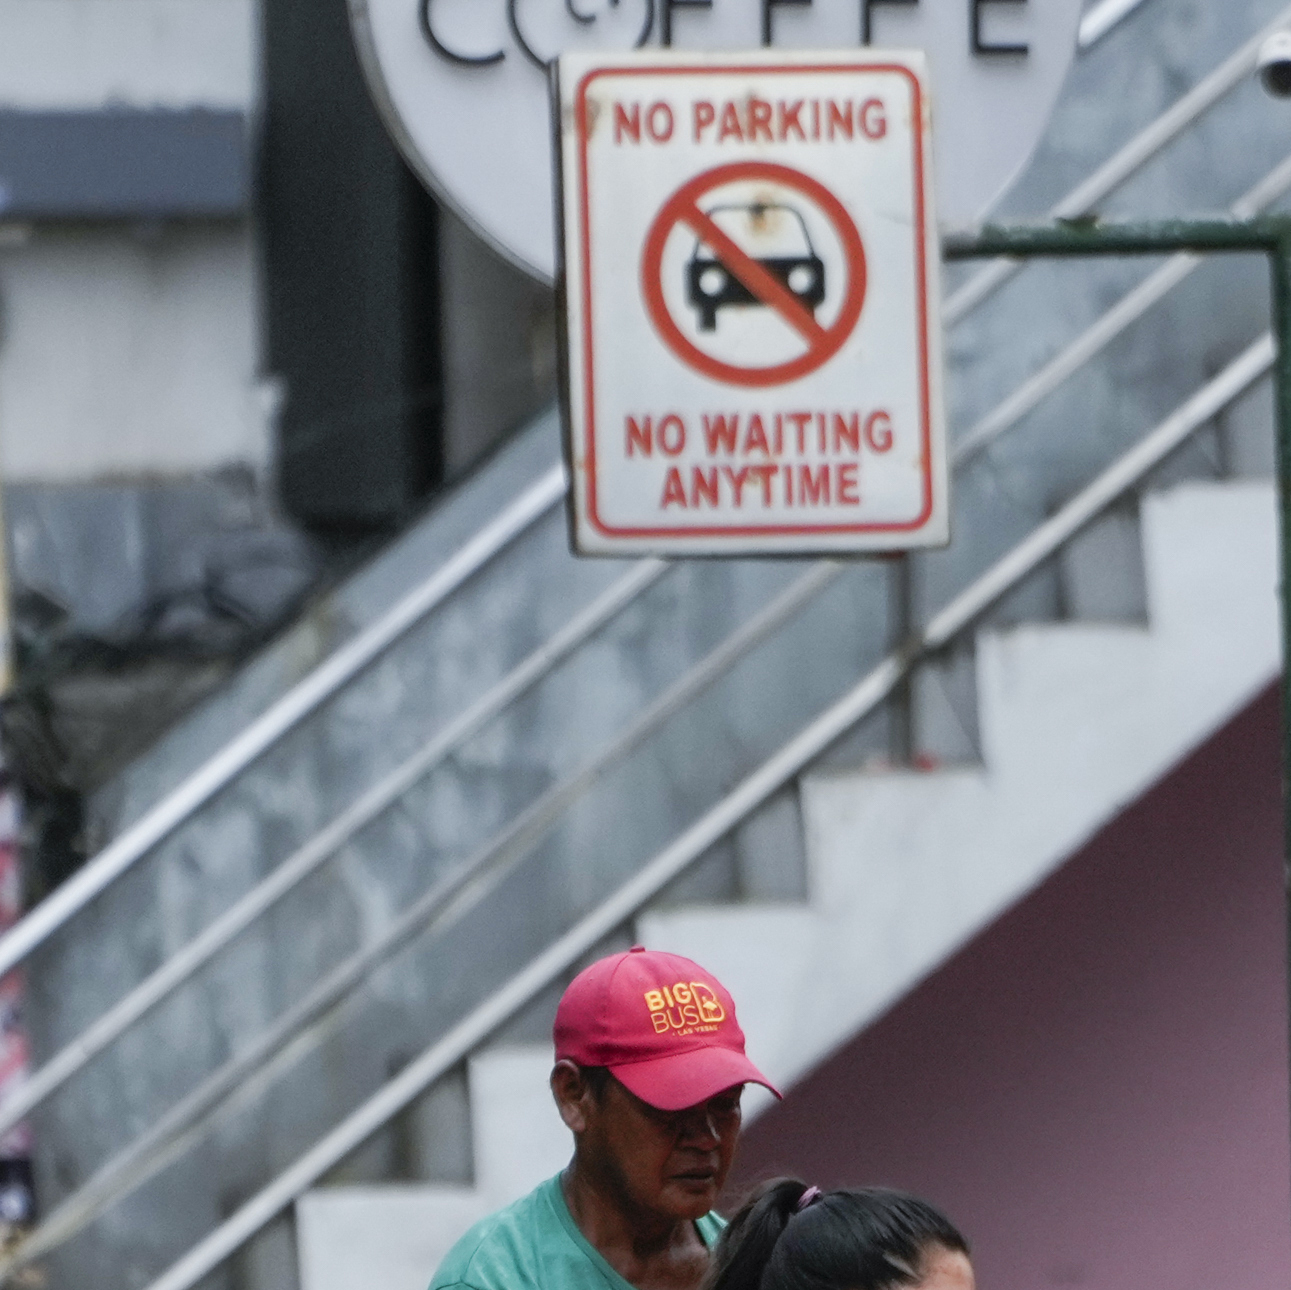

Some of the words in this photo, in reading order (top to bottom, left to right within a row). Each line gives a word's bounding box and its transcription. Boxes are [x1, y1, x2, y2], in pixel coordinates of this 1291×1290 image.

[613, 100, 674, 145] NO
[691, 98, 888, 145] PARKING
[624, 412, 686, 459] NO
[702, 410, 893, 456] WAITING
[659, 462, 860, 509] ANYTIME
[644, 983, 692, 1012] BIG
[651, 1004, 700, 1034] BUS
[677, 1027, 694, 1036] LAS
